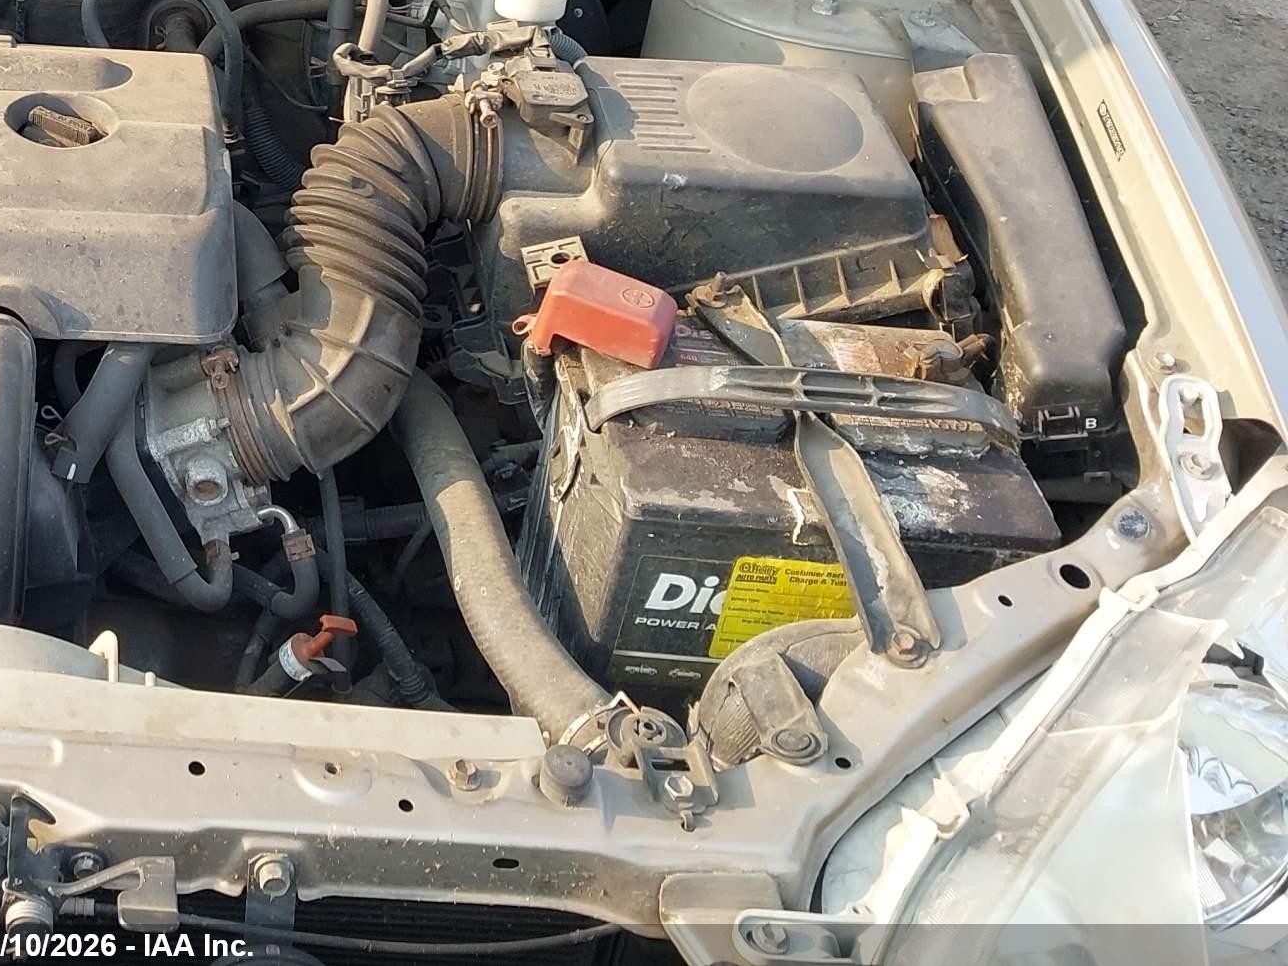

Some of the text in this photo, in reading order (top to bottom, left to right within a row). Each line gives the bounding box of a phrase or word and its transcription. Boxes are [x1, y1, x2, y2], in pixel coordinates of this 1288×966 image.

[1085, 418, 1097, 429] B
[789, 576, 819, 585] Charge
[634, 616, 700, 630] POWER
